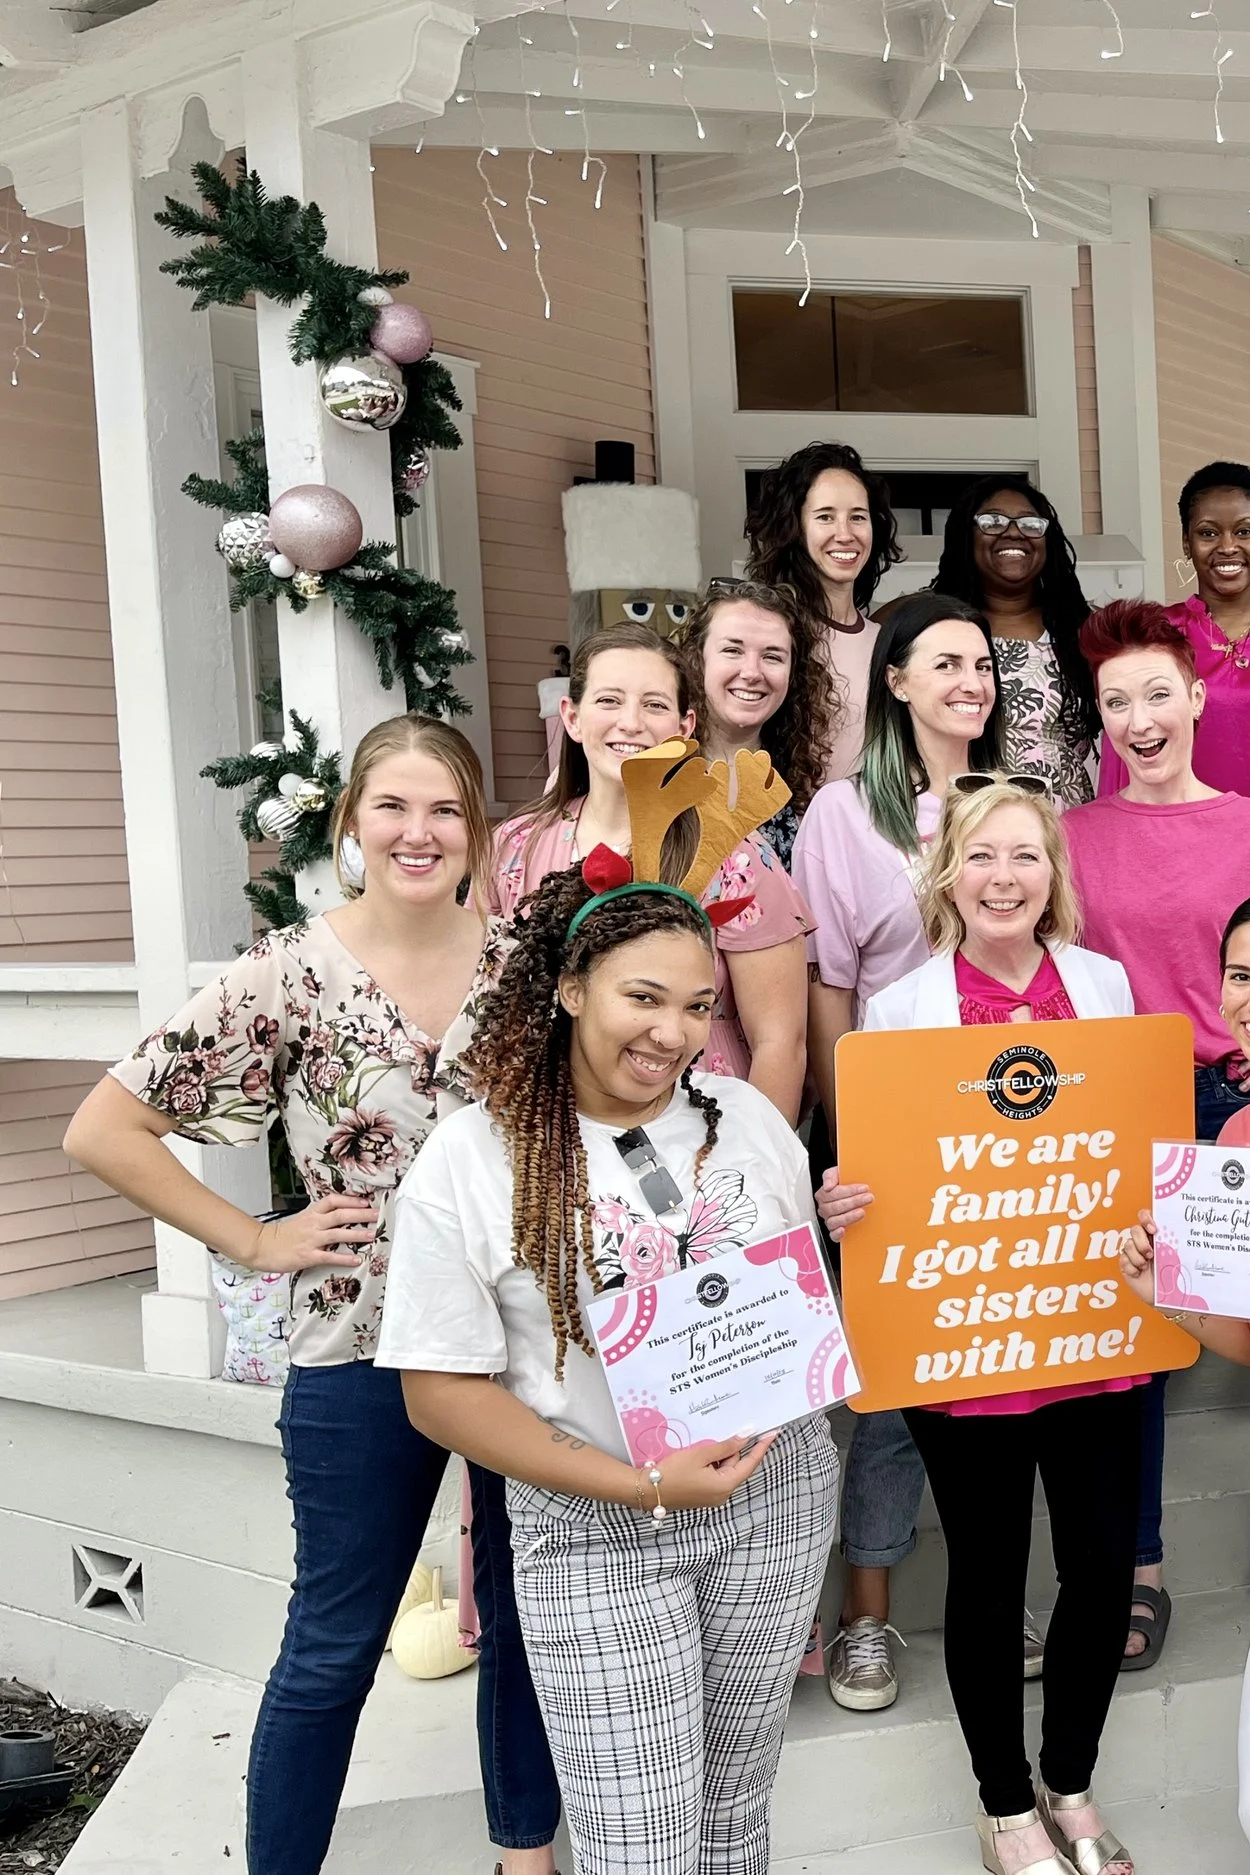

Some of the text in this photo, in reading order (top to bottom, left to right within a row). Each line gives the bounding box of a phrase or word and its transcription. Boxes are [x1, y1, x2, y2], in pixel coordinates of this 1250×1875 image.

[996, 1046, 1047, 1064] SEMINOLE
[957, 1072, 1086, 1094] CHRISTFELLOWSHIP
[1002, 1105, 1044, 1119] HEIGHTS
[937, 1130, 1115, 1172] We are
[927, 1168, 1120, 1226] family!
[1181, 1193, 1196, 1201] This
[1197, 1195, 1235, 1204] certificate
[1236, 1197, 1243, 1205] is
[1184, 1205, 1229, 1225] Christina
[1186, 1239, 1201, 1248] STS
[1203, 1241, 1235, 1251] Women's
[1202, 1230, 1214, 1238] the
[878, 1223, 1132, 1290] I got all m
[646, 1336, 670, 1349] This
[672, 1315, 722, 1338] certificate
[724, 1310, 733, 1319] is
[735, 1291, 777, 1314] awarded
[779, 1288, 789, 1297] to
[933, 1279, 1118, 1328] sisters
[708, 1320, 766, 1350] Peterson
[914, 1316, 1142, 1383] with me!
[669, 1380, 691, 1396] STS
[693, 1362, 739, 1386] Women's
[740, 1338, 798, 1367] Discipleship
[671, 1328, 790, 1382] for the completion of the
